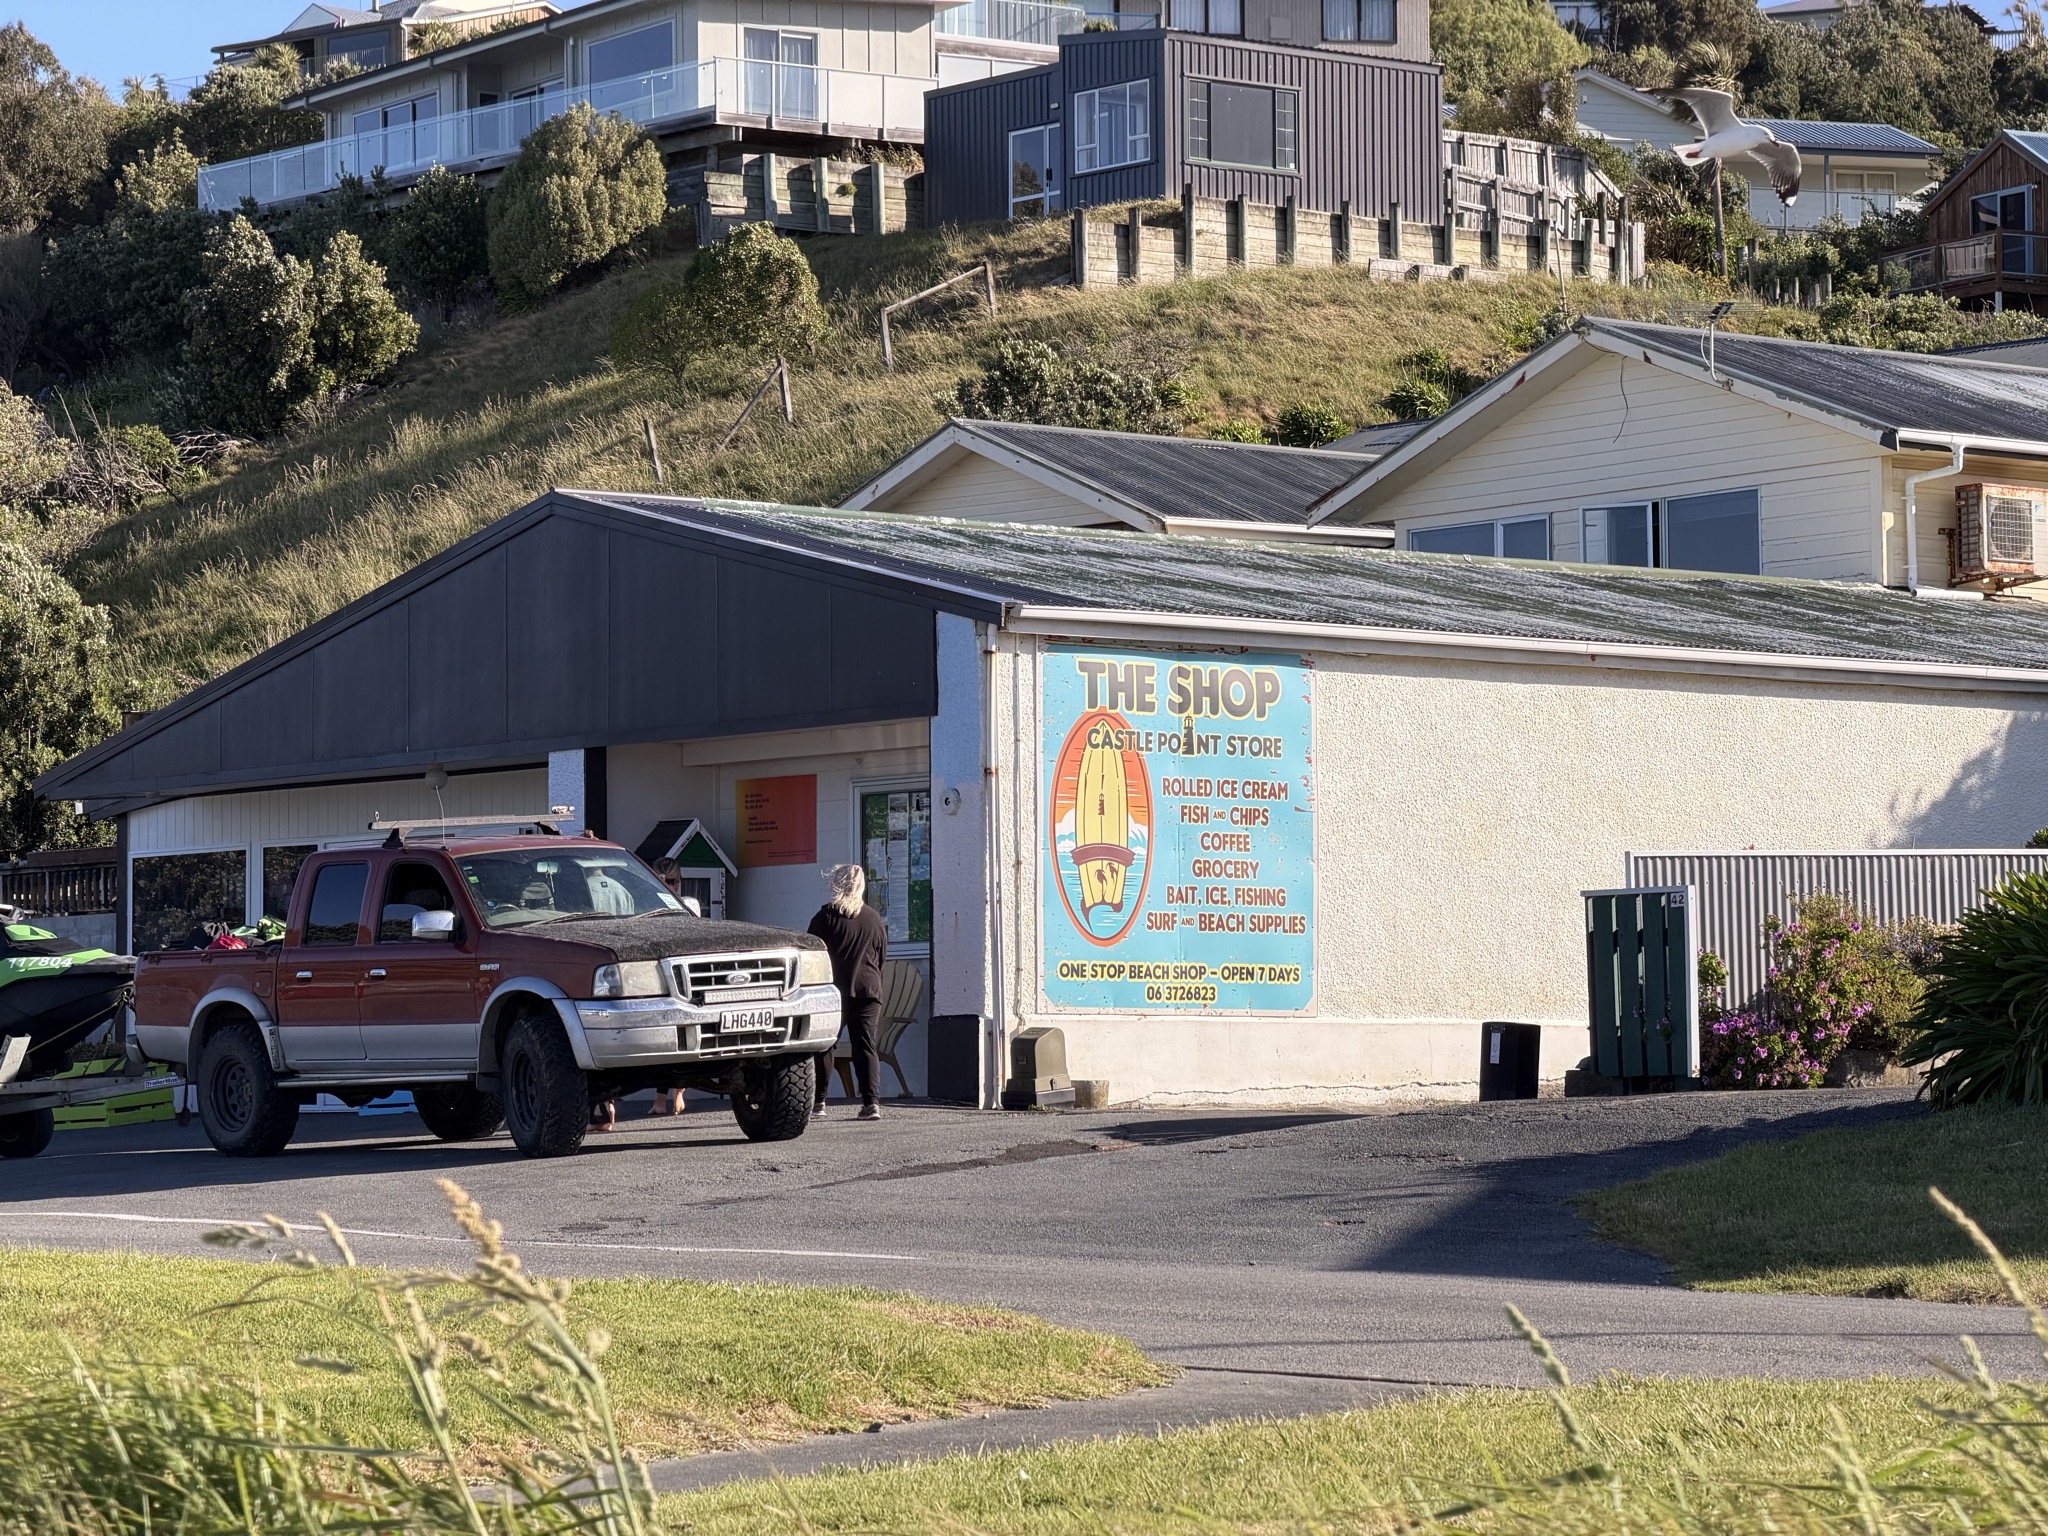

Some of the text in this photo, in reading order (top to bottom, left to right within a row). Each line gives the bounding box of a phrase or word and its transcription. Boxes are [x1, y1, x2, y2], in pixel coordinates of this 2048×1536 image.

[1077, 660, 1280, 719] THE SHOP
[1087, 727, 1152, 752] CASTLE
[1226, 735, 1283, 758] STORE
[1162, 777, 1289, 801] ROLLED ICE CREAM
[1180, 805, 1269, 827] FISH AND CHIPS
[1200, 833, 1251, 853] COFFEE
[1192, 859, 1260, 880] GROCERY
[1166, 886, 1287, 907] BAIT, ICE, FISHING
[1671, 894, 1684, 905] 42
[1146, 912, 1306, 935] SURF AND BEACH SUPPLIES
[7, 956, 74, 969] 117804
[1059, 962, 1087, 978] ONE
[1090, 963, 1126, 979] STOP
[1128, 963, 1170, 980] BEACH
[1172, 965, 1207, 981] SHOP
[1221, 965, 1256, 982] OPEN
[1258, 966, 1265, 982] 7
[1268, 967, 1300, 983] DAYS
[1146, 986, 1217, 1002] 06 3726823
[722, 1011, 772, 1030] LHG440
